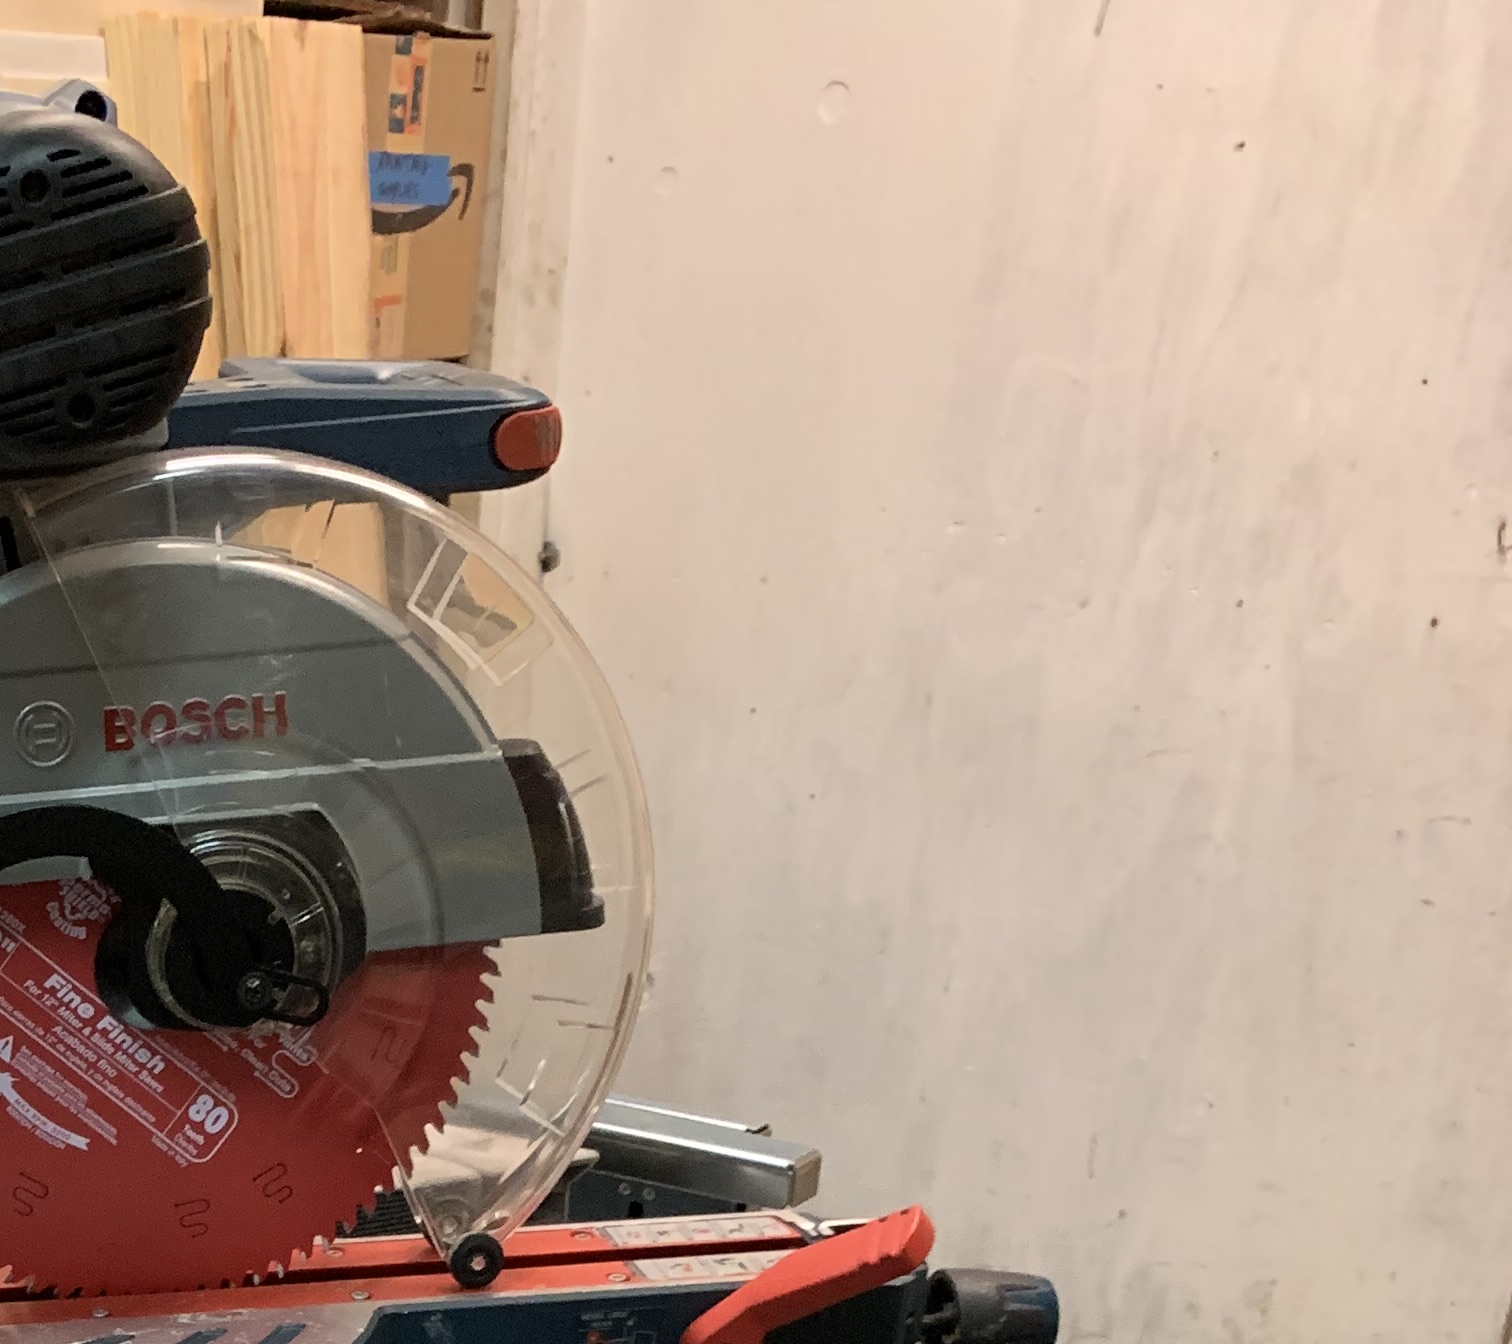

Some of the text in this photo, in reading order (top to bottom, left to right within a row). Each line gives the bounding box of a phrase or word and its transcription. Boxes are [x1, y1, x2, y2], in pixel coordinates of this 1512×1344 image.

[102, 690, 287, 752] BOSCH
[22, 978, 43, 997] For
[56, 1004, 85, 1030] Miter
[112, 1049, 141, 1075] Miter
[43, 972, 95, 1020] Fine
[96, 1015, 166, 1075] Finish
[50, 1022, 100, 1063] Acabado
[187, 1093, 230, 1135] 80
